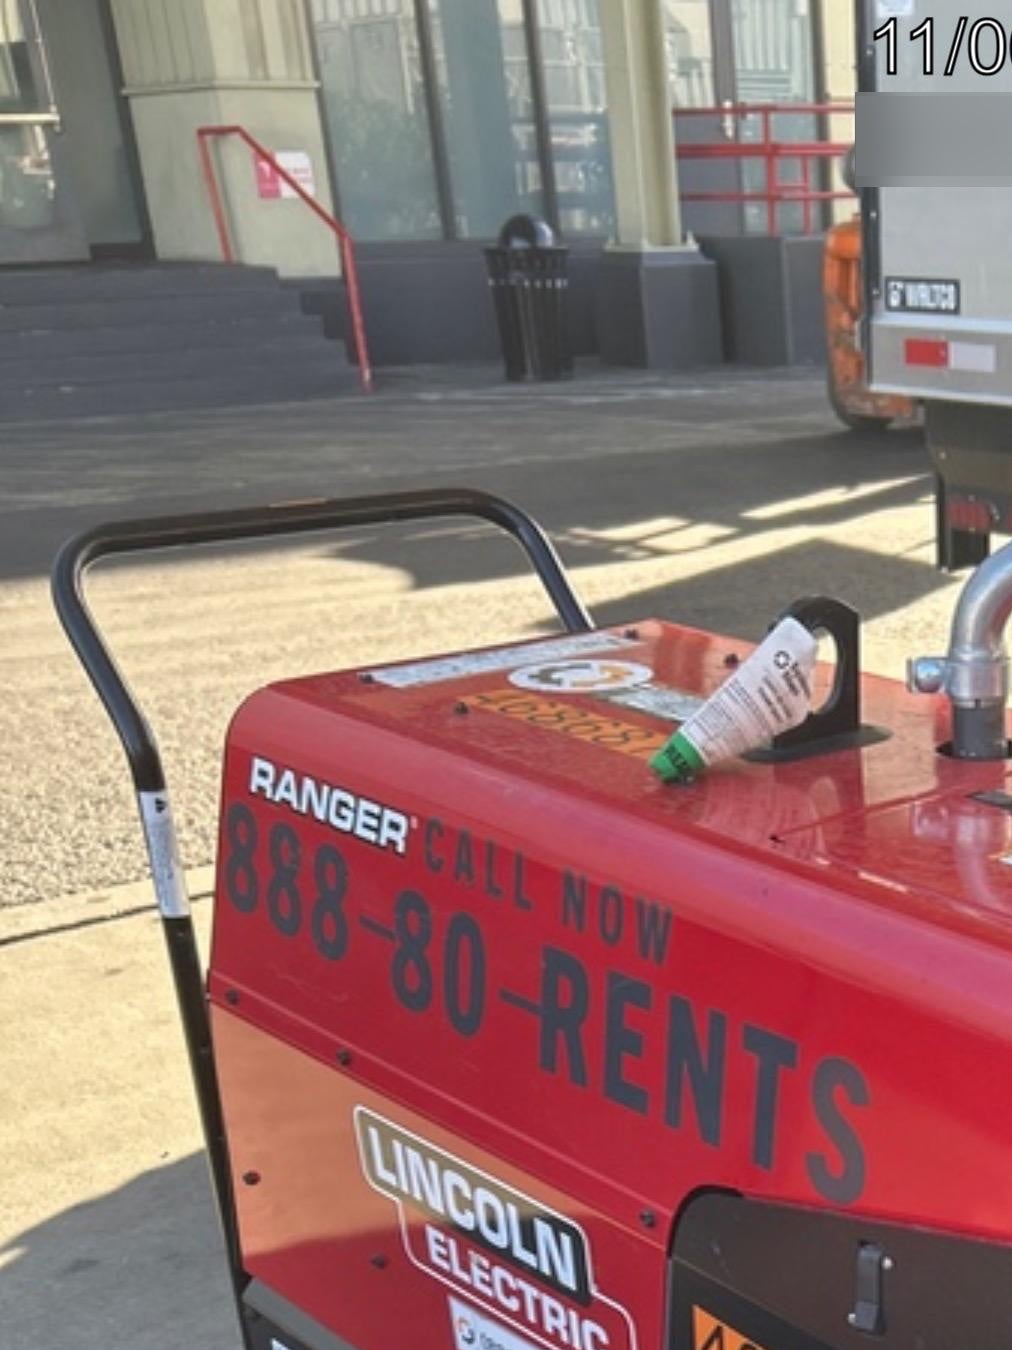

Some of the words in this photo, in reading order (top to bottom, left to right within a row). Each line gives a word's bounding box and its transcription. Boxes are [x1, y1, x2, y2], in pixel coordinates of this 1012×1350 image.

[250, 757, 409, 854] RANGER
[424, 816, 532, 910] CALL
[562, 870, 672, 966] NOW
[225, 803, 870, 1205] 888-80-RENTS
[369, 1126, 577, 1292] LINCOLN
